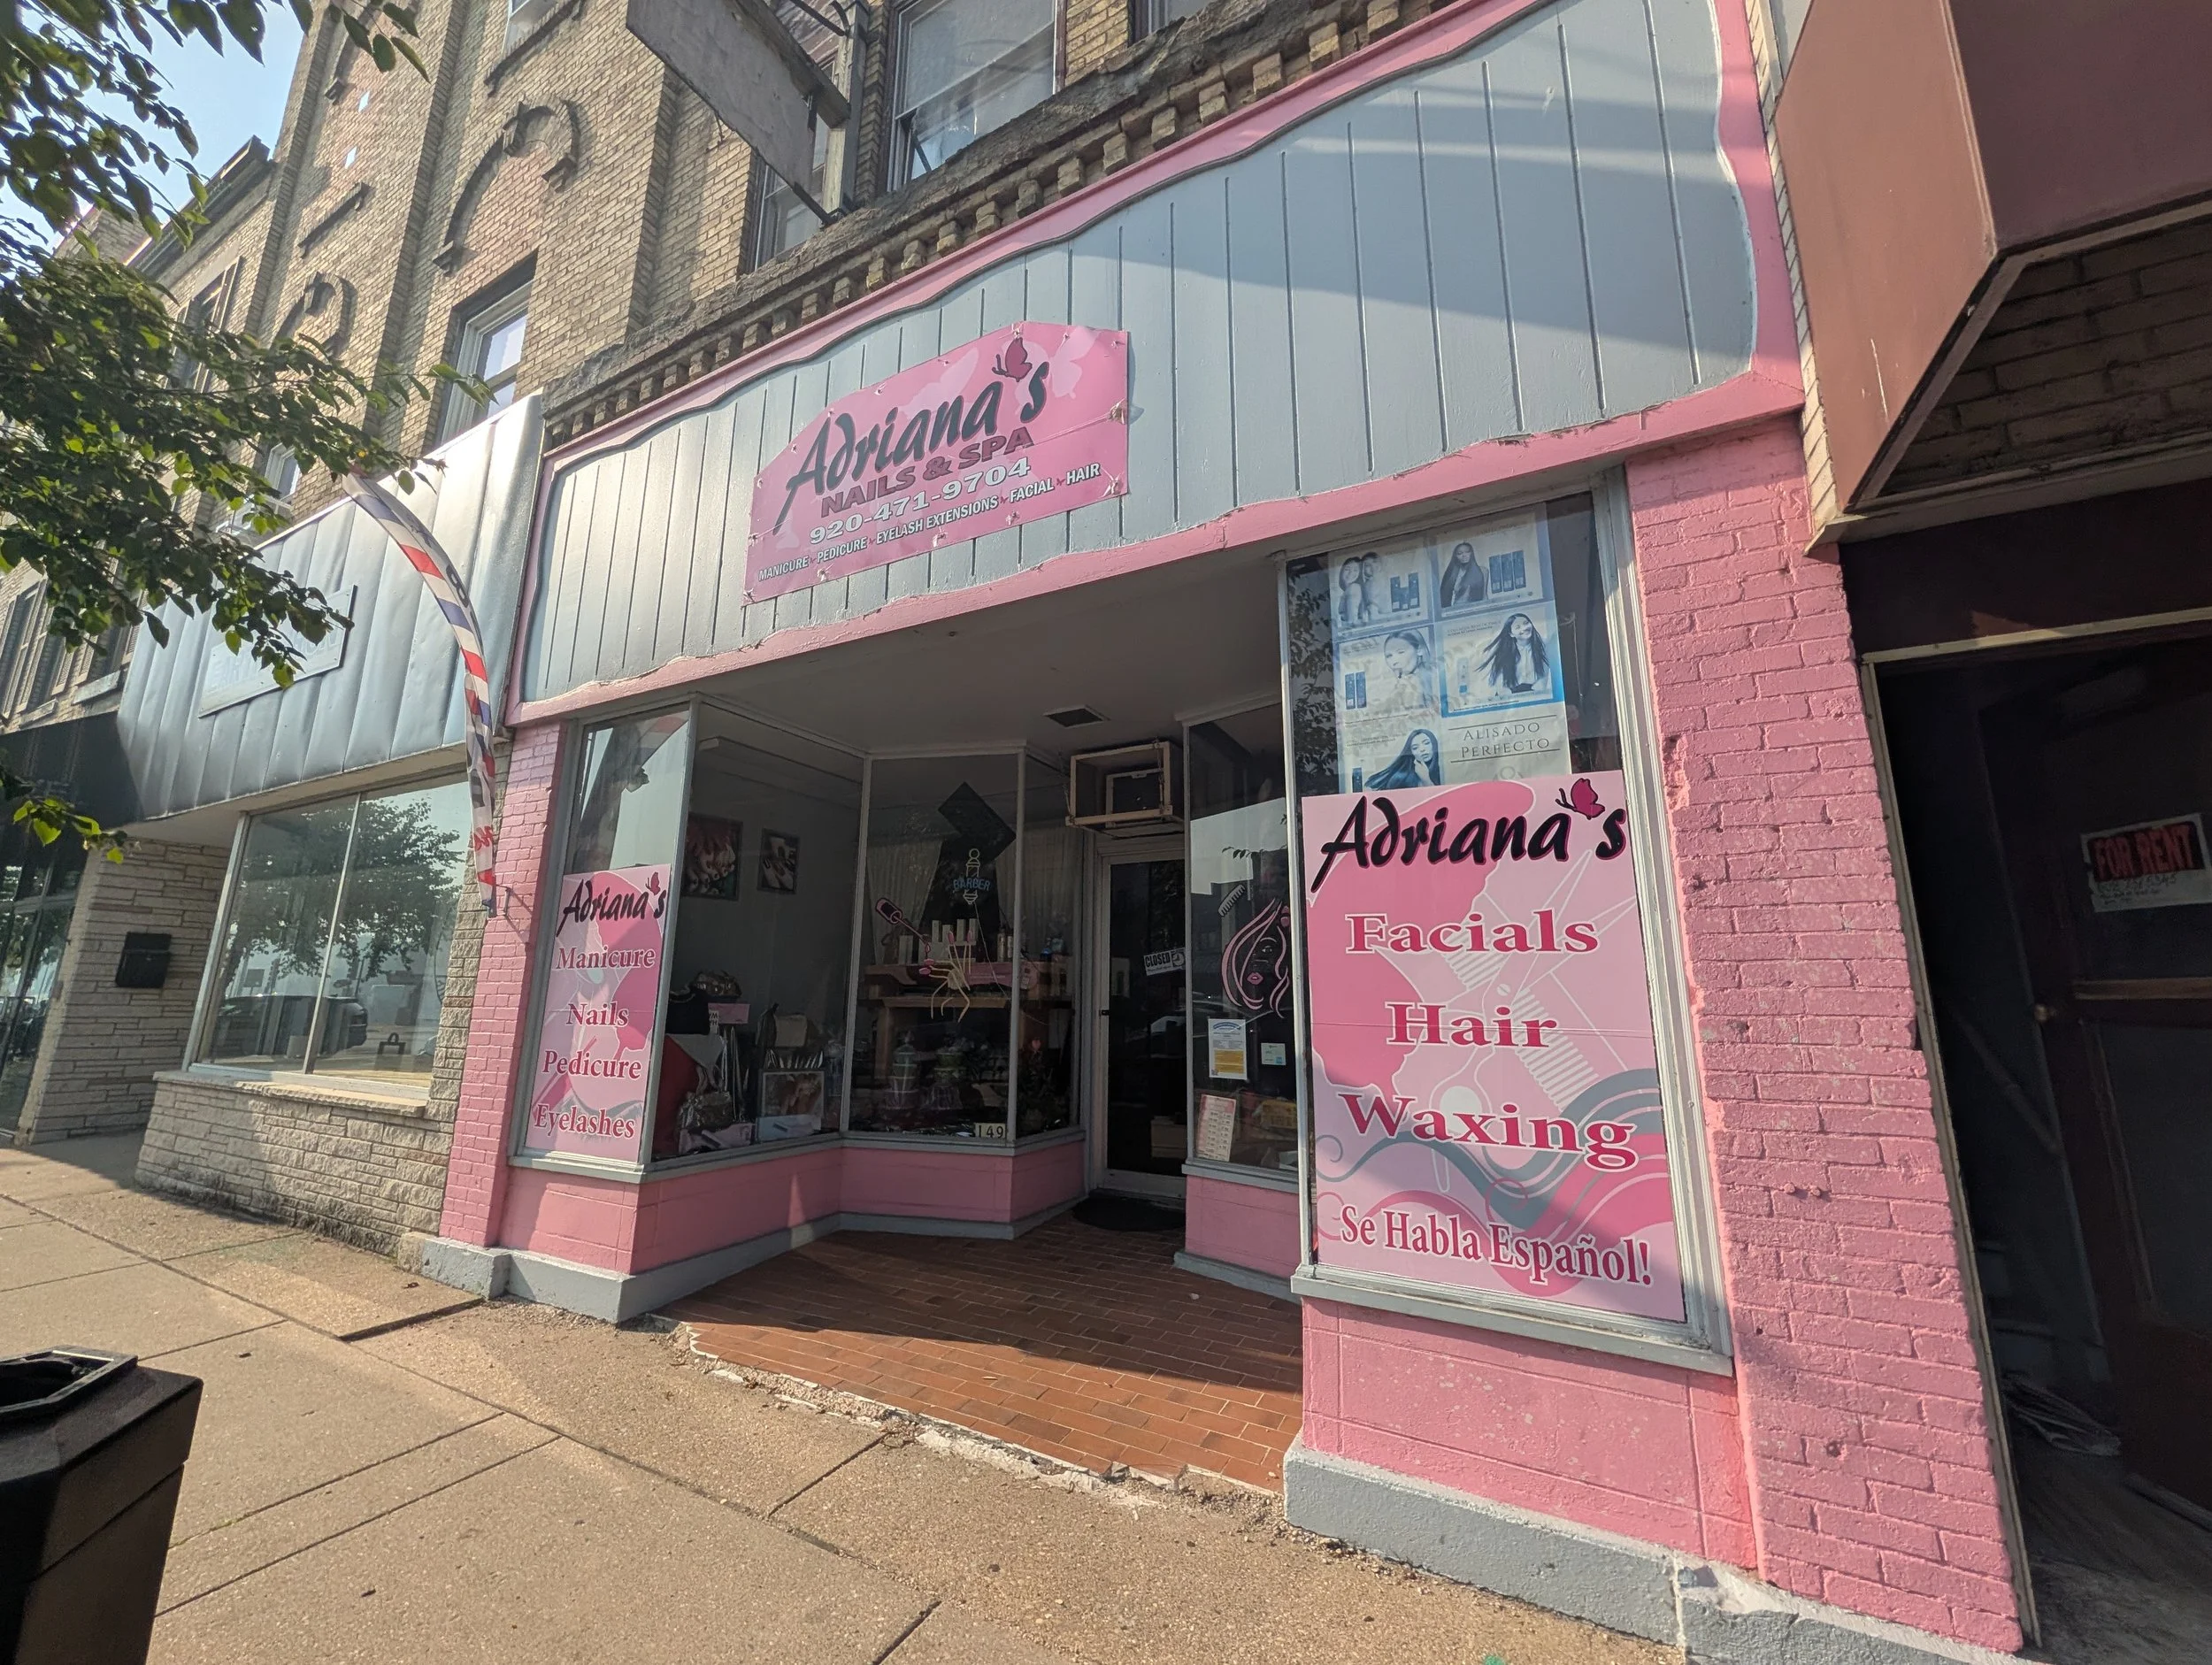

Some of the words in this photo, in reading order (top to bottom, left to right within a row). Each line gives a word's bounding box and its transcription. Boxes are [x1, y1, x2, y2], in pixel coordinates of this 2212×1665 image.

[821, 464, 916, 518] NAILS
[924, 456, 953, 480] &
[958, 426, 1034, 467] SPA
[809, 457, 1031, 544] 920-471-9704
[758, 556, 810, 582] MANICURE
[817, 537, 868, 564] PEDICURE
[876, 518, 924, 545] EYELASH
[926, 495, 998, 528] EXTENSIONS
[1010, 478, 1055, 503] FACIAL
[1065, 463, 1101, 486] HAIR
[1462, 738, 1549, 759] PERFECTO
[1463, 722, 1540, 741] ALISADO
[2093, 836, 2134, 881] FOR
[2134, 825, 2193, 873] RENT
[953, 877, 990, 892] BARBER
[1345, 908, 1599, 954] Facials
[557, 947, 656, 970] Manicure
[1145, 952, 1171, 967] CLOSED
[566, 1001, 628, 1026] Nails
[1386, 1001, 1557, 1048] Hair
[542, 1050, 641, 1079] Pedicure
[534, 1103, 634, 1139] Eyelashes
[979, 1125, 1003, 1139] 149
[1338, 1093, 1638, 1171] Waxing
[1341, 1205, 1376, 1247] Se
[1382, 1210, 1481, 1262] Habla
[1488, 1222, 1651, 1286] Español!
